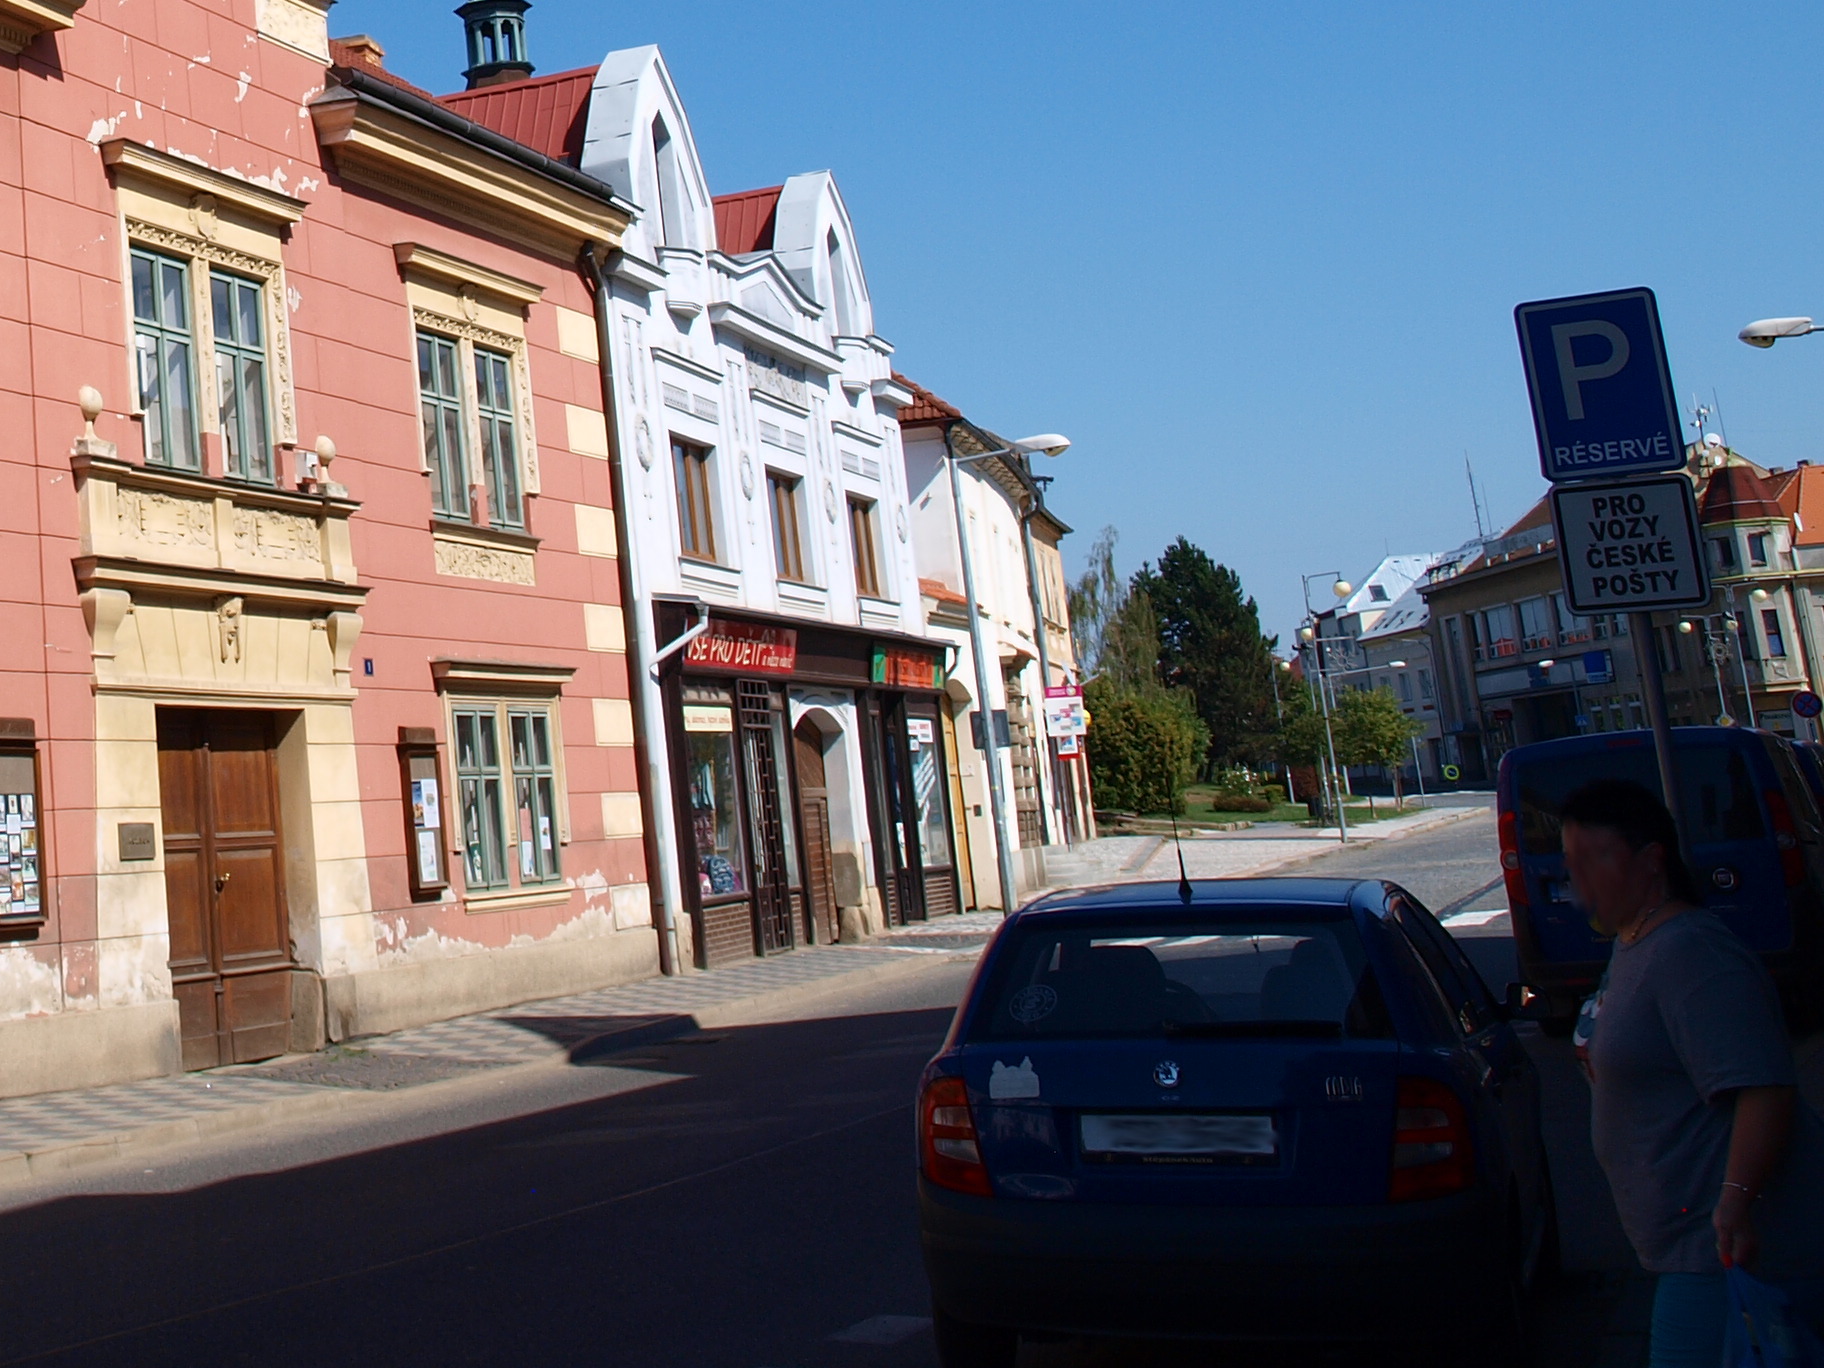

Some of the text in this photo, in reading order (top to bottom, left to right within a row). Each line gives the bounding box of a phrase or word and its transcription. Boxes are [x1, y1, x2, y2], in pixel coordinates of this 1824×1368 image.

[1551, 320, 1630, 420] P
[1555, 432, 1670, 466] RÉSERVÉ
[1592, 493, 1646, 519] PRO
[1588, 514, 1660, 542] VOZY
[1586, 536, 1675, 569] ČESKÉ
[1592, 568, 1680, 598] POŠTY
[710, 634, 735, 664] PRO
